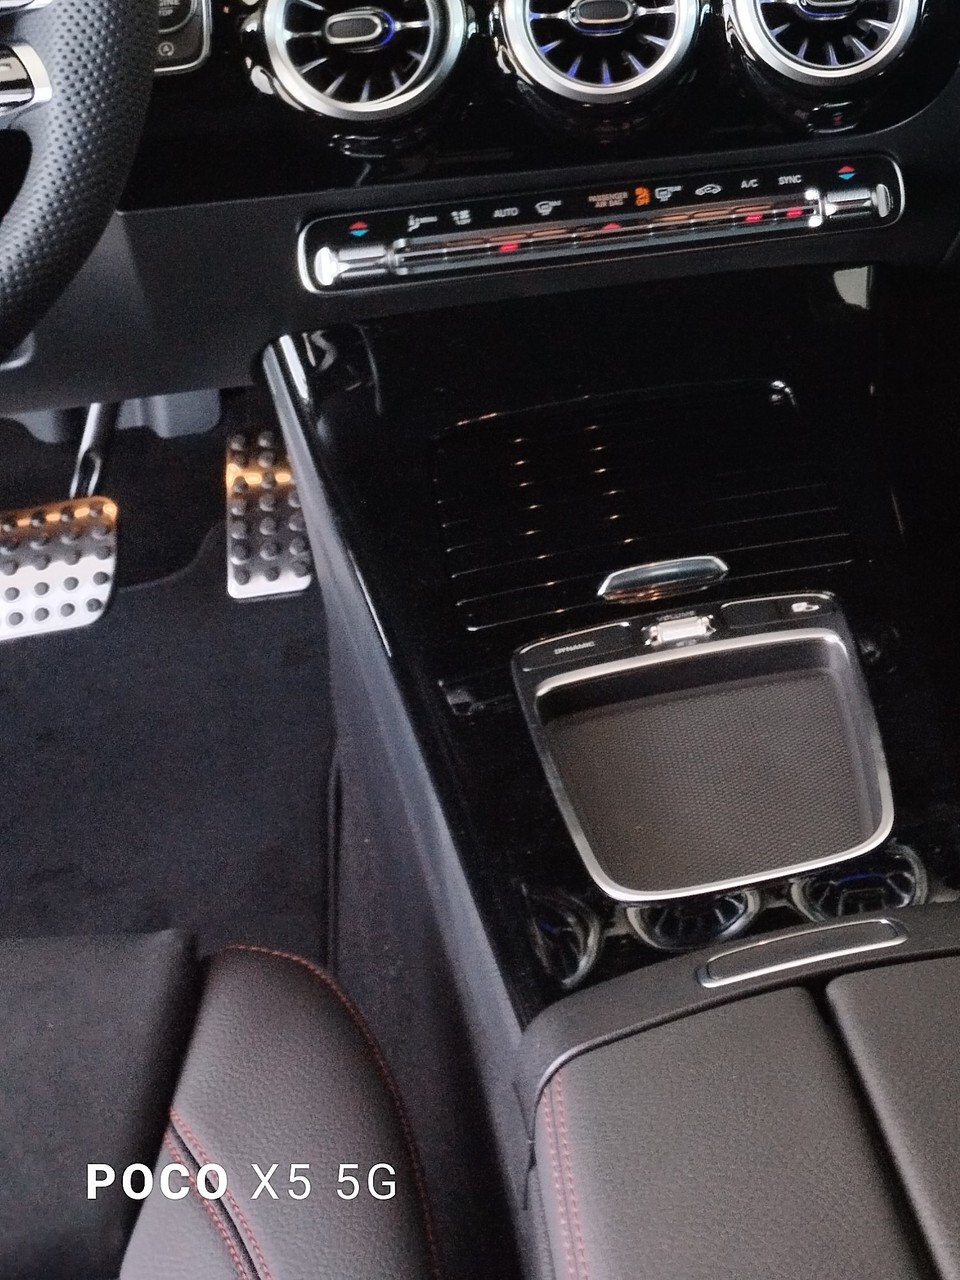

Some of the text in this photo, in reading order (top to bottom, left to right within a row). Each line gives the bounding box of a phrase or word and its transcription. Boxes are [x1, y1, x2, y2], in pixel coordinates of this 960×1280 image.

[741, 178, 759, 189] A/C
[778, 174, 802, 186] SYNC
[493, 207, 519, 218] AUTO
[553, 641, 595, 655] DYNAMIC
